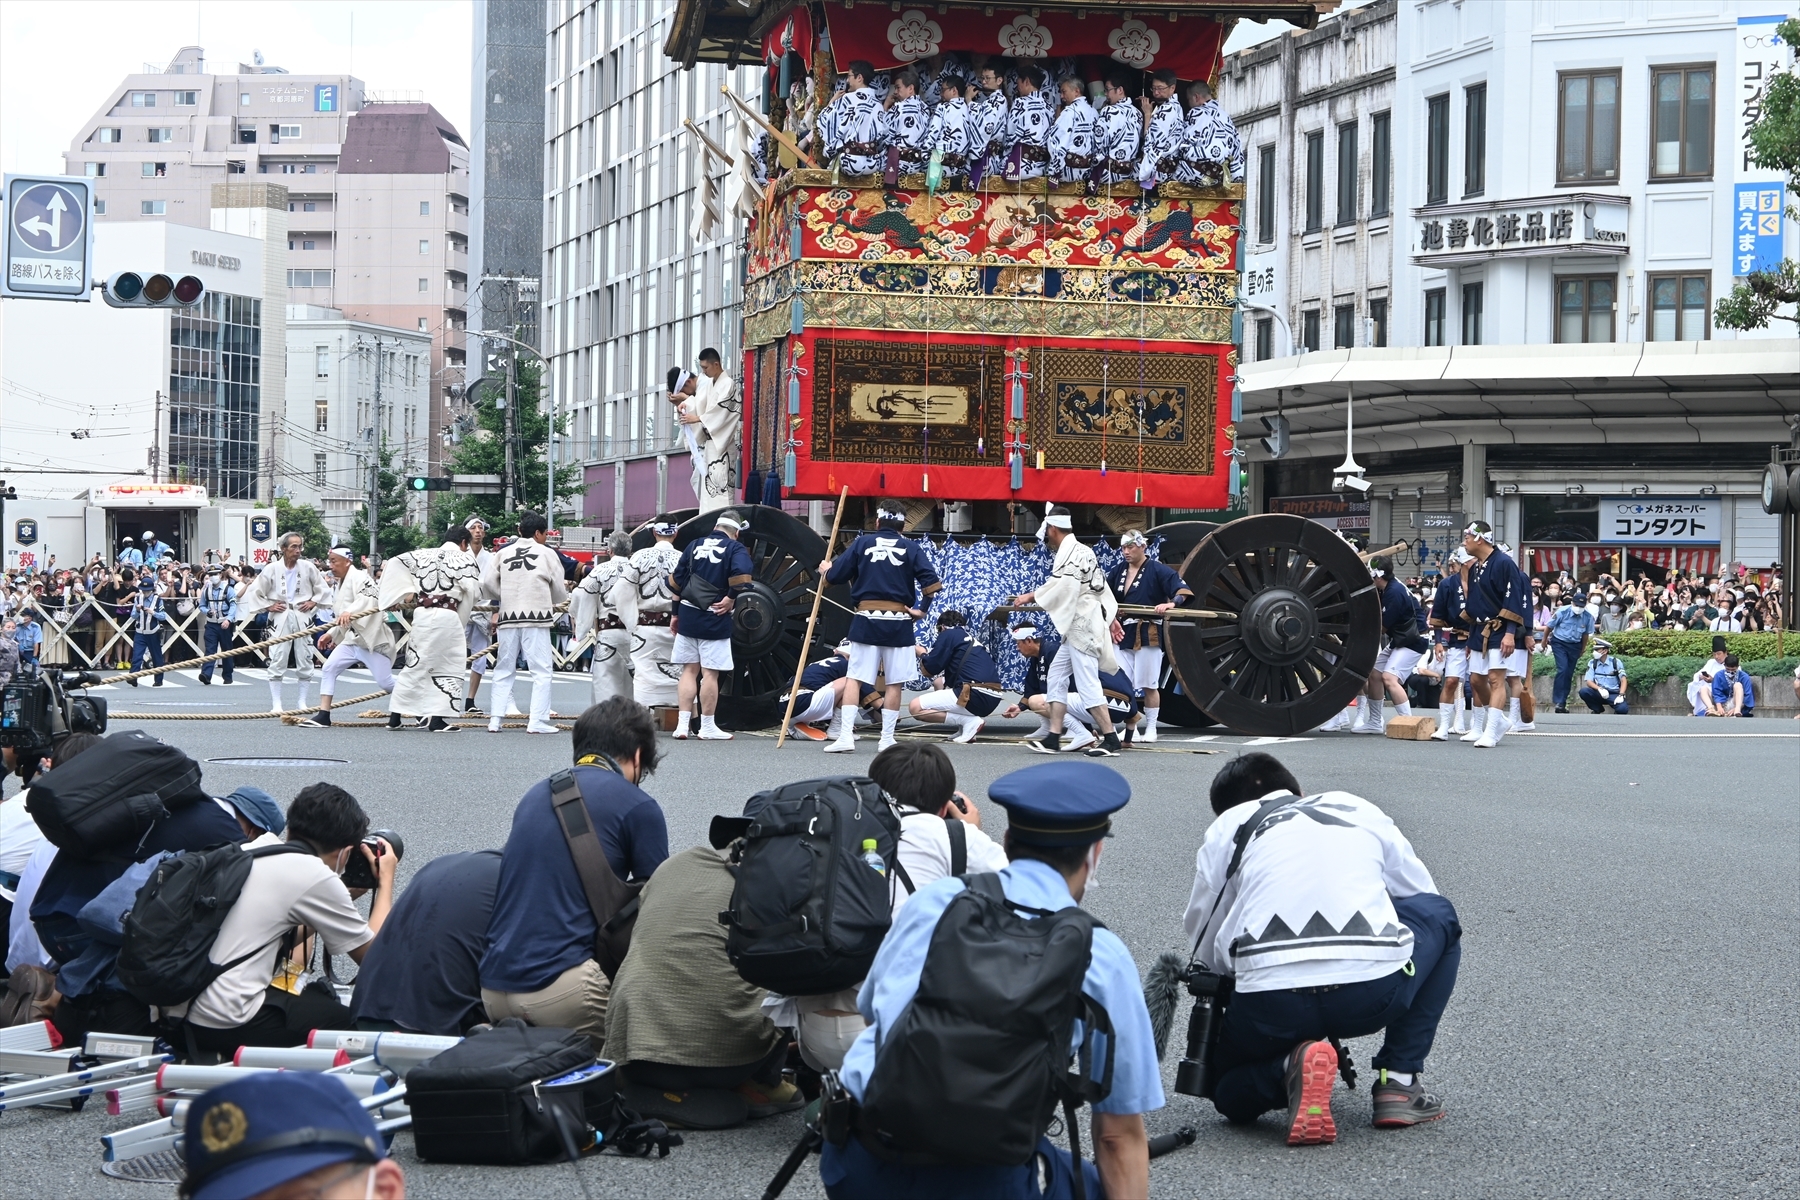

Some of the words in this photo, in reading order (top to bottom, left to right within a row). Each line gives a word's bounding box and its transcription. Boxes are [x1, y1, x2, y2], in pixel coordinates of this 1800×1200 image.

[262, 87, 310, 95] エステムコート
[1760, 192, 1778, 234] すぐ
[1421, 208, 1574, 250] 池善化粧品店
[1738, 191, 1757, 273] 買えます
[190, 250, 217, 268] TAKU
[217, 254, 242, 271] SEED
[11, 263, 82, 281] 路線バスを除く
[1282, 502, 1349, 514] アクセスチケット
[1645, 504, 1706, 514] メガネスーパー
[1337, 518, 1354, 528] ACCESS
[1616, 518, 1706, 536] コンタクト
[253, 548, 268, 563] 救
